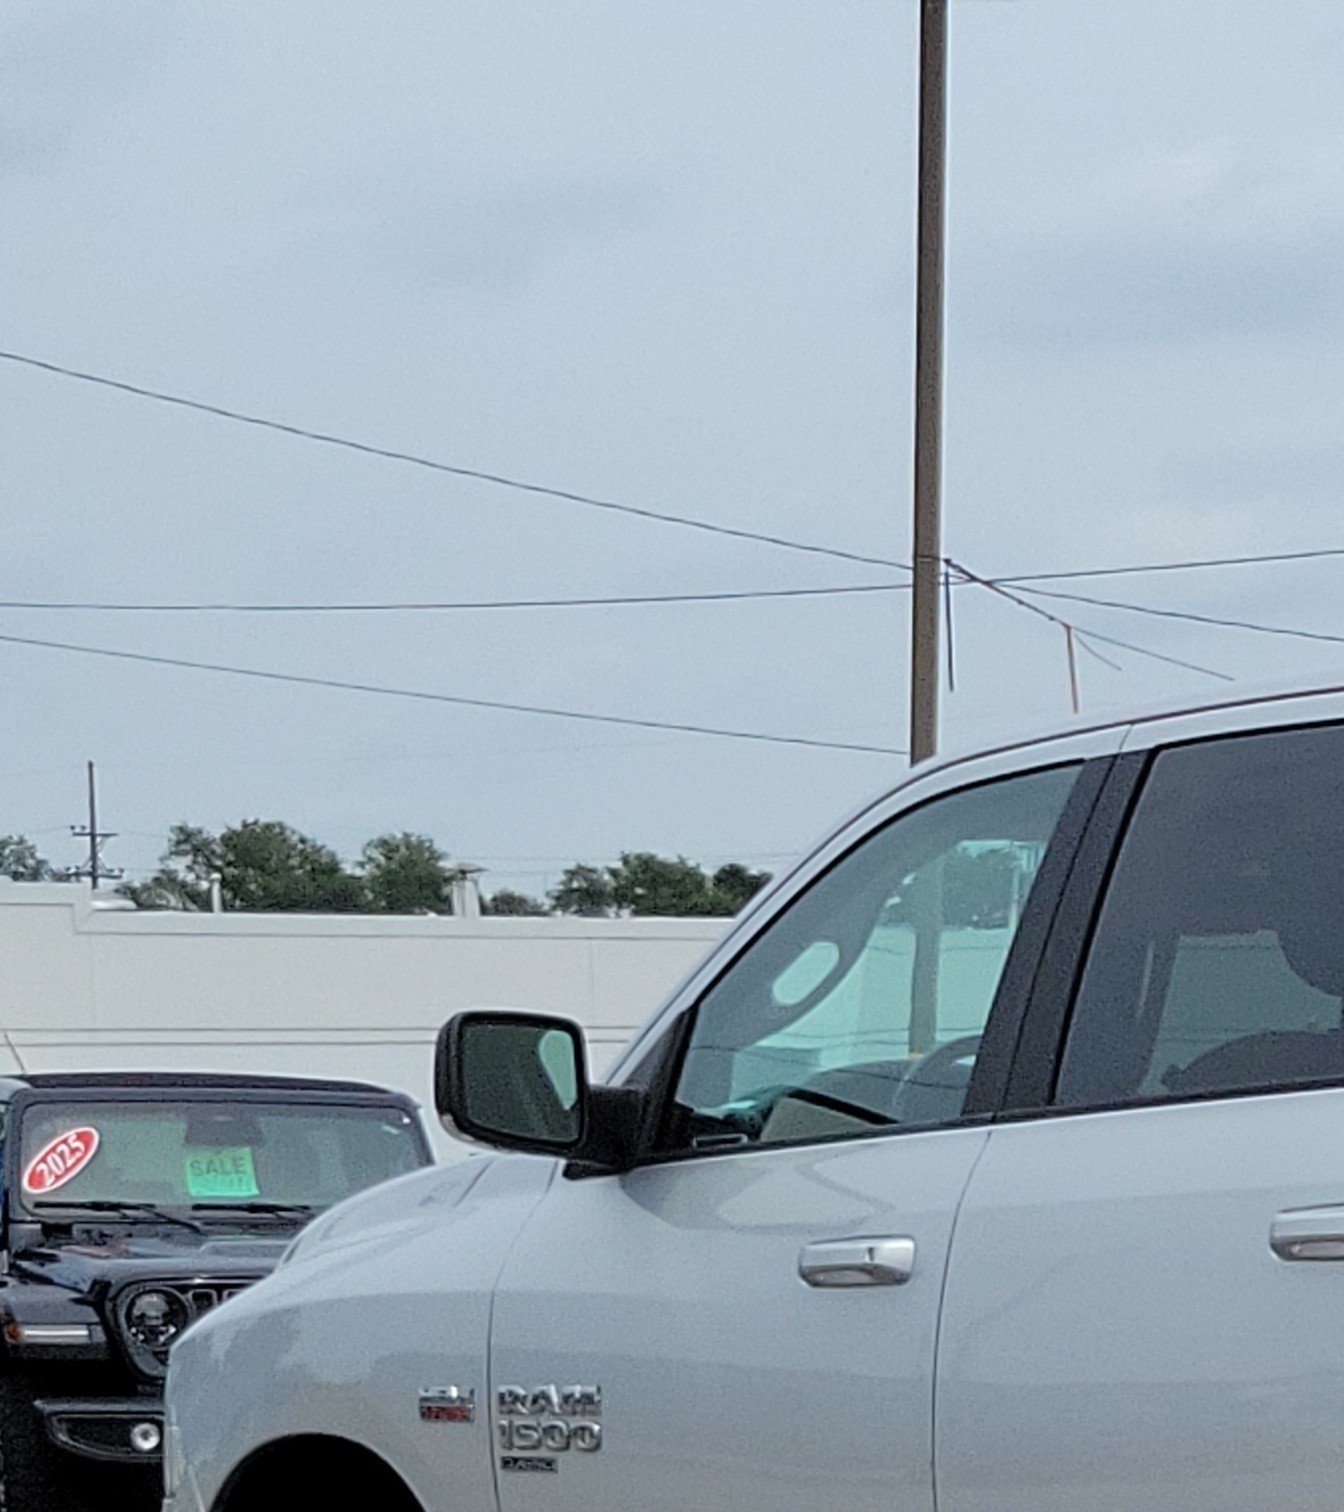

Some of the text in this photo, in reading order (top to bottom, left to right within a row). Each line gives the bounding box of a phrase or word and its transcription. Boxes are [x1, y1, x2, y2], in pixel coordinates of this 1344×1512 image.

[35, 1133, 86, 1187] 2025
[189, 1156, 249, 1176] SALE
[498, 1384, 602, 1416] RAM
[498, 1420, 602, 1452] 1500
